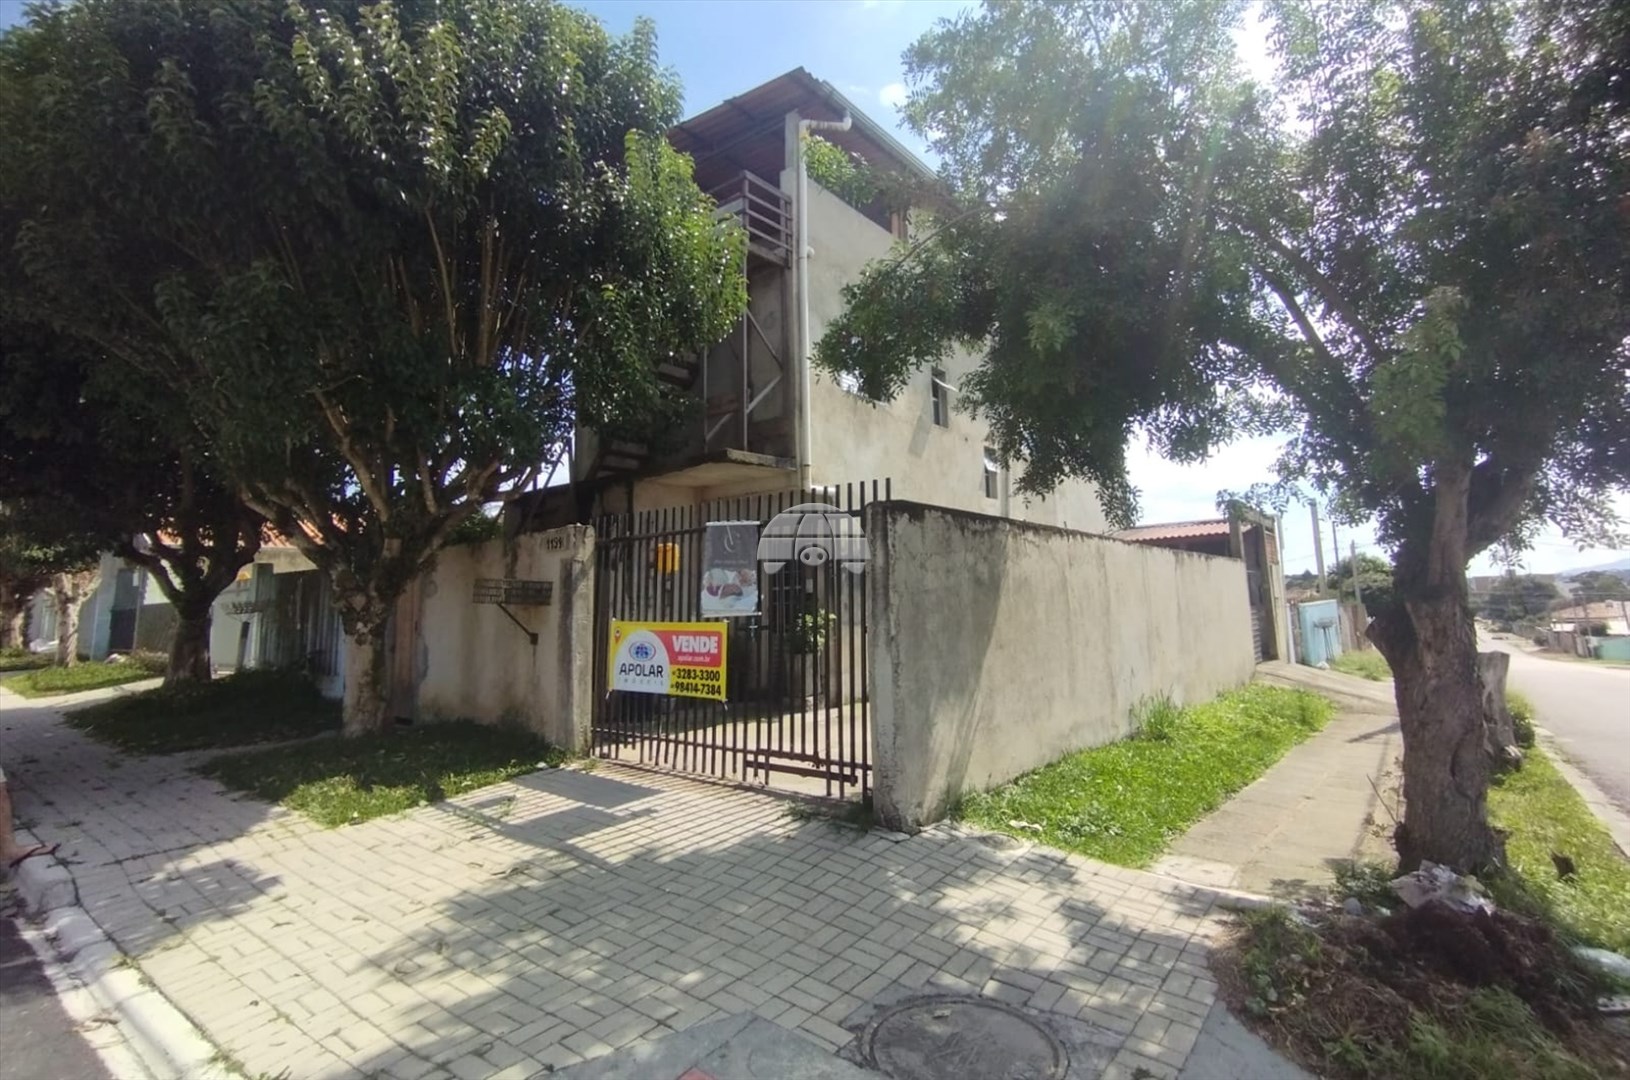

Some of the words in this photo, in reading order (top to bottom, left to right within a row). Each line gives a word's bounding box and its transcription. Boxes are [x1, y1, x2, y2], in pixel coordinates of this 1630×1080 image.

[672, 635, 719, 654] VENDE
[619, 663, 664, 678] APOLAR
[676, 668, 721, 682] 3283-3300
[675, 681, 722, 696] 98414-7384
